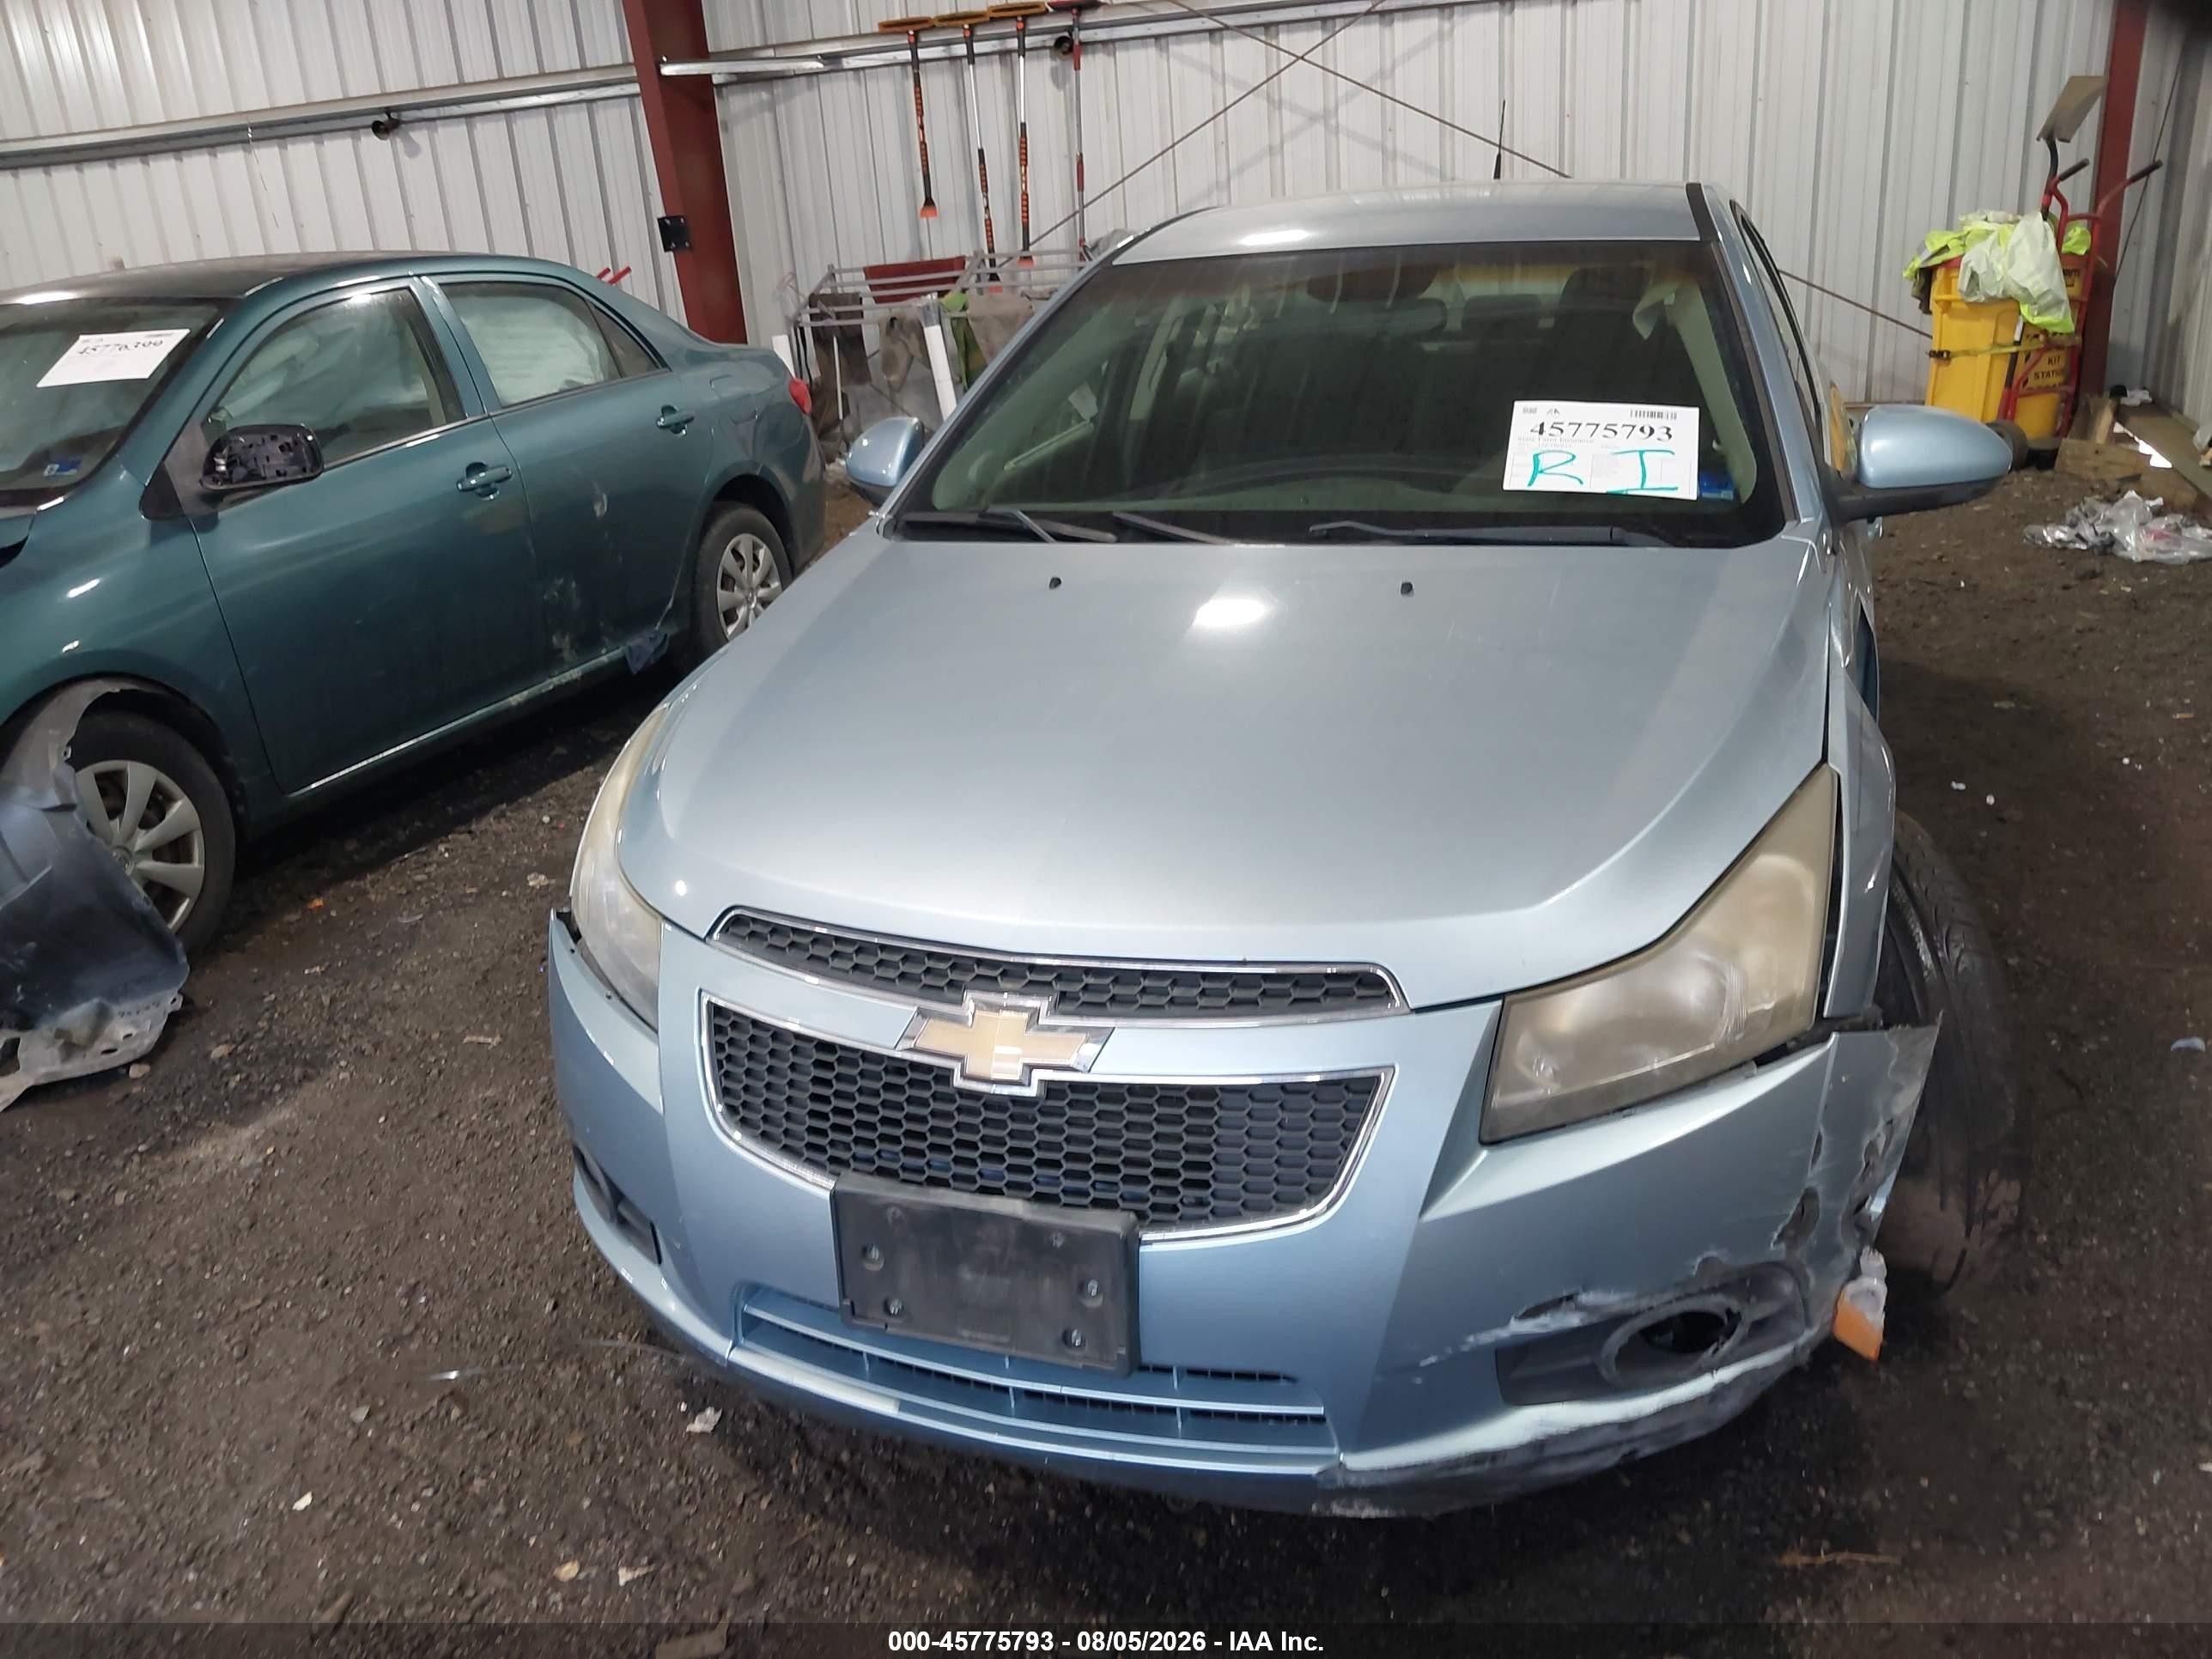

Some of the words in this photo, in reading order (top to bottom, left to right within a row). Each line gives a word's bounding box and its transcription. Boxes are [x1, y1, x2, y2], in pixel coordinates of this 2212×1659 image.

[2047, 356, 2061, 366] KIT
[1529, 421, 1673, 442] 45775793
[1528, 450, 1583, 487] R
[1606, 450, 1678, 494] I
